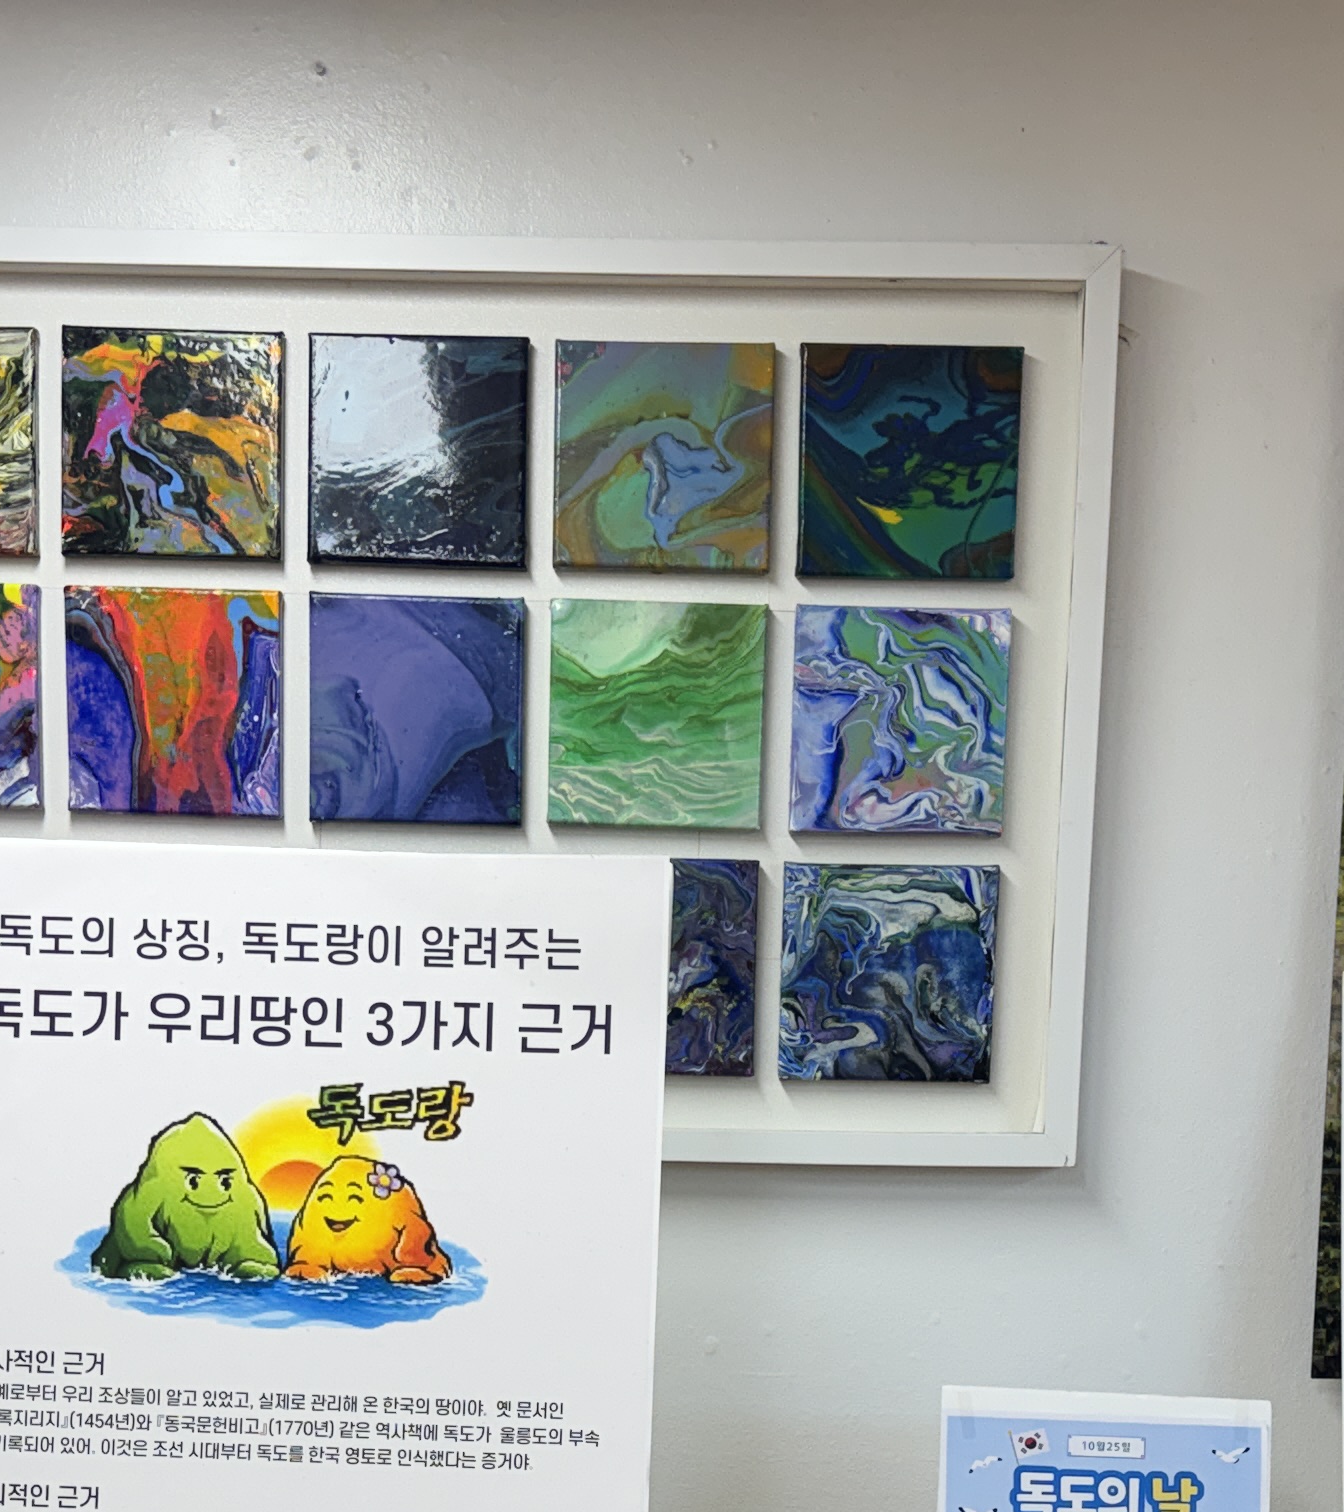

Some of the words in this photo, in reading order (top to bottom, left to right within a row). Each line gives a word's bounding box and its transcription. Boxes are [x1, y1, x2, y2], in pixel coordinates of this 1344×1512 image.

[133, 917, 224, 966] 상징,
[242, 920, 402, 967] 독도랑이
[421, 925, 582, 972] 알려주는
[147, 992, 343, 1049] 우리땅인
[366, 999, 494, 1053] 3가지
[518, 1002, 612, 1055] 근거
[307, 1080, 474, 1147] 독도랑
[62, 1351, 105, 1376] 근거
[62, 1384, 93, 1405] 우리
[97, 1385, 161, 1407] 조상들이
[166, 1387, 197, 1408] 알고
[202, 1389, 254, 1411] 있었고,
[258, 1391, 306, 1412] 실제로
[310, 1393, 358, 1413] 관리해
[362, 1395, 378, 1415] 온
[383, 1396, 430, 1417] 한국의
[435, 1397, 487, 1418] 땅이야.
[496, 1399, 512, 1419] 옛
[516, 1400, 564, 1421] 문서인
[60, 1435, 96, 1456] 있어.
[100, 1437, 148, 1459] 이것은
[152, 1439, 184, 1460] 조선
[188, 1441, 252, 1462] 시대부터
[256, 1443, 304, 1464] 독도를
[308, 1445, 340, 1465] 한국
[345, 1446, 392, 1466] 영토로
[397, 1448, 477, 1470] 인식했다는
[339, 1420, 371, 1440] 같은
[375, 1422, 439, 1442] 역사책에
[443, 1424, 492, 1444] 독도가
[500, 1426, 563, 1446] 울릉도의
[568, 1428, 600, 1449] 부속
[57, 1484, 99, 1510] 근거
